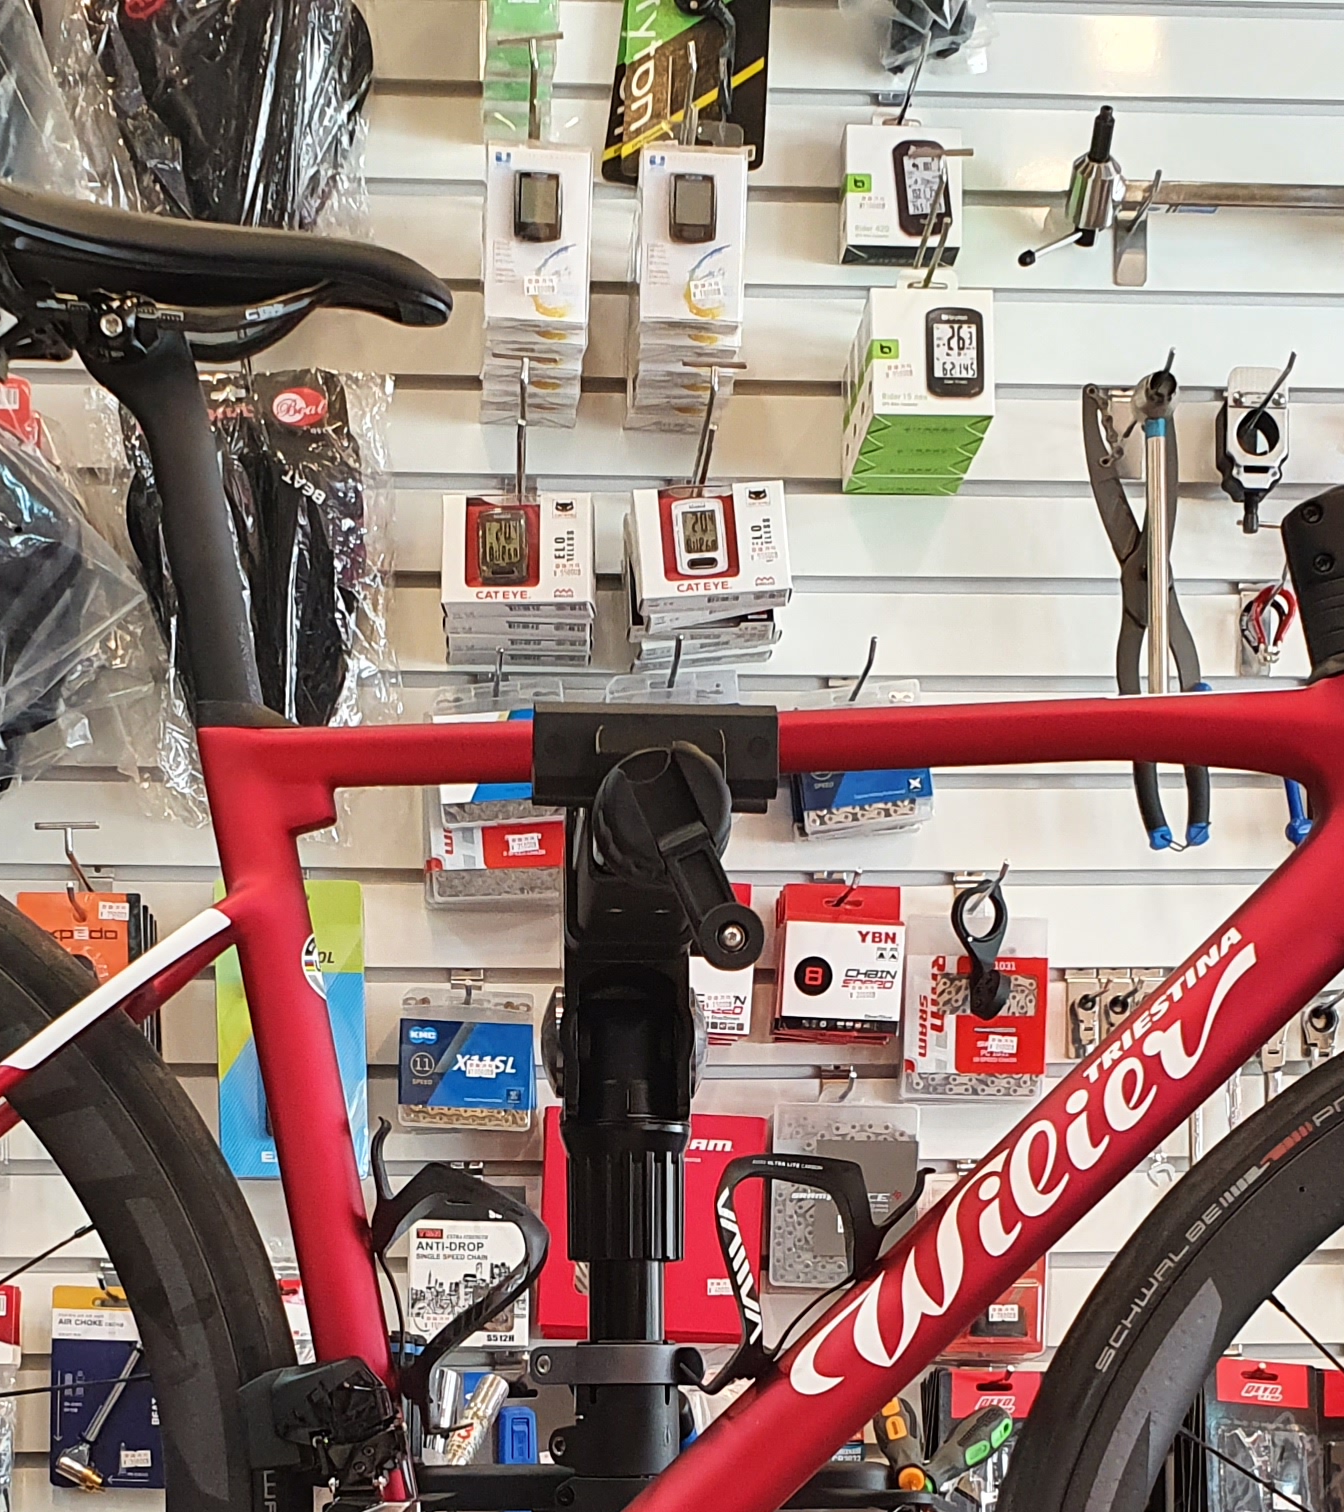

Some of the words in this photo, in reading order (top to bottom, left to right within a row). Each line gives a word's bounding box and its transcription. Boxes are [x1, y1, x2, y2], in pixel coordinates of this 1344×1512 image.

[281, 468, 327, 505] BEAT
[677, 580, 732, 593] CATEYE
[476, 590, 532, 600] CATEYE
[857, 931, 898, 945] YBN
[805, 966, 824, 986] 8
[844, 968, 898, 980] CHAIN
[1082, 927, 1244, 1084] TRIESTINA
[918, 994, 929, 1058] SRAM
[409, 1030, 438, 1041] KMC
[789, 941, 1258, 1397] Wilier
[416, 1241, 485, 1252] ANTI-DROP
[1094, 1203, 1225, 1374] SCHWALBE
[58, 1318, 73, 1327] AIR
[74, 1318, 103, 1327] CHOKE
